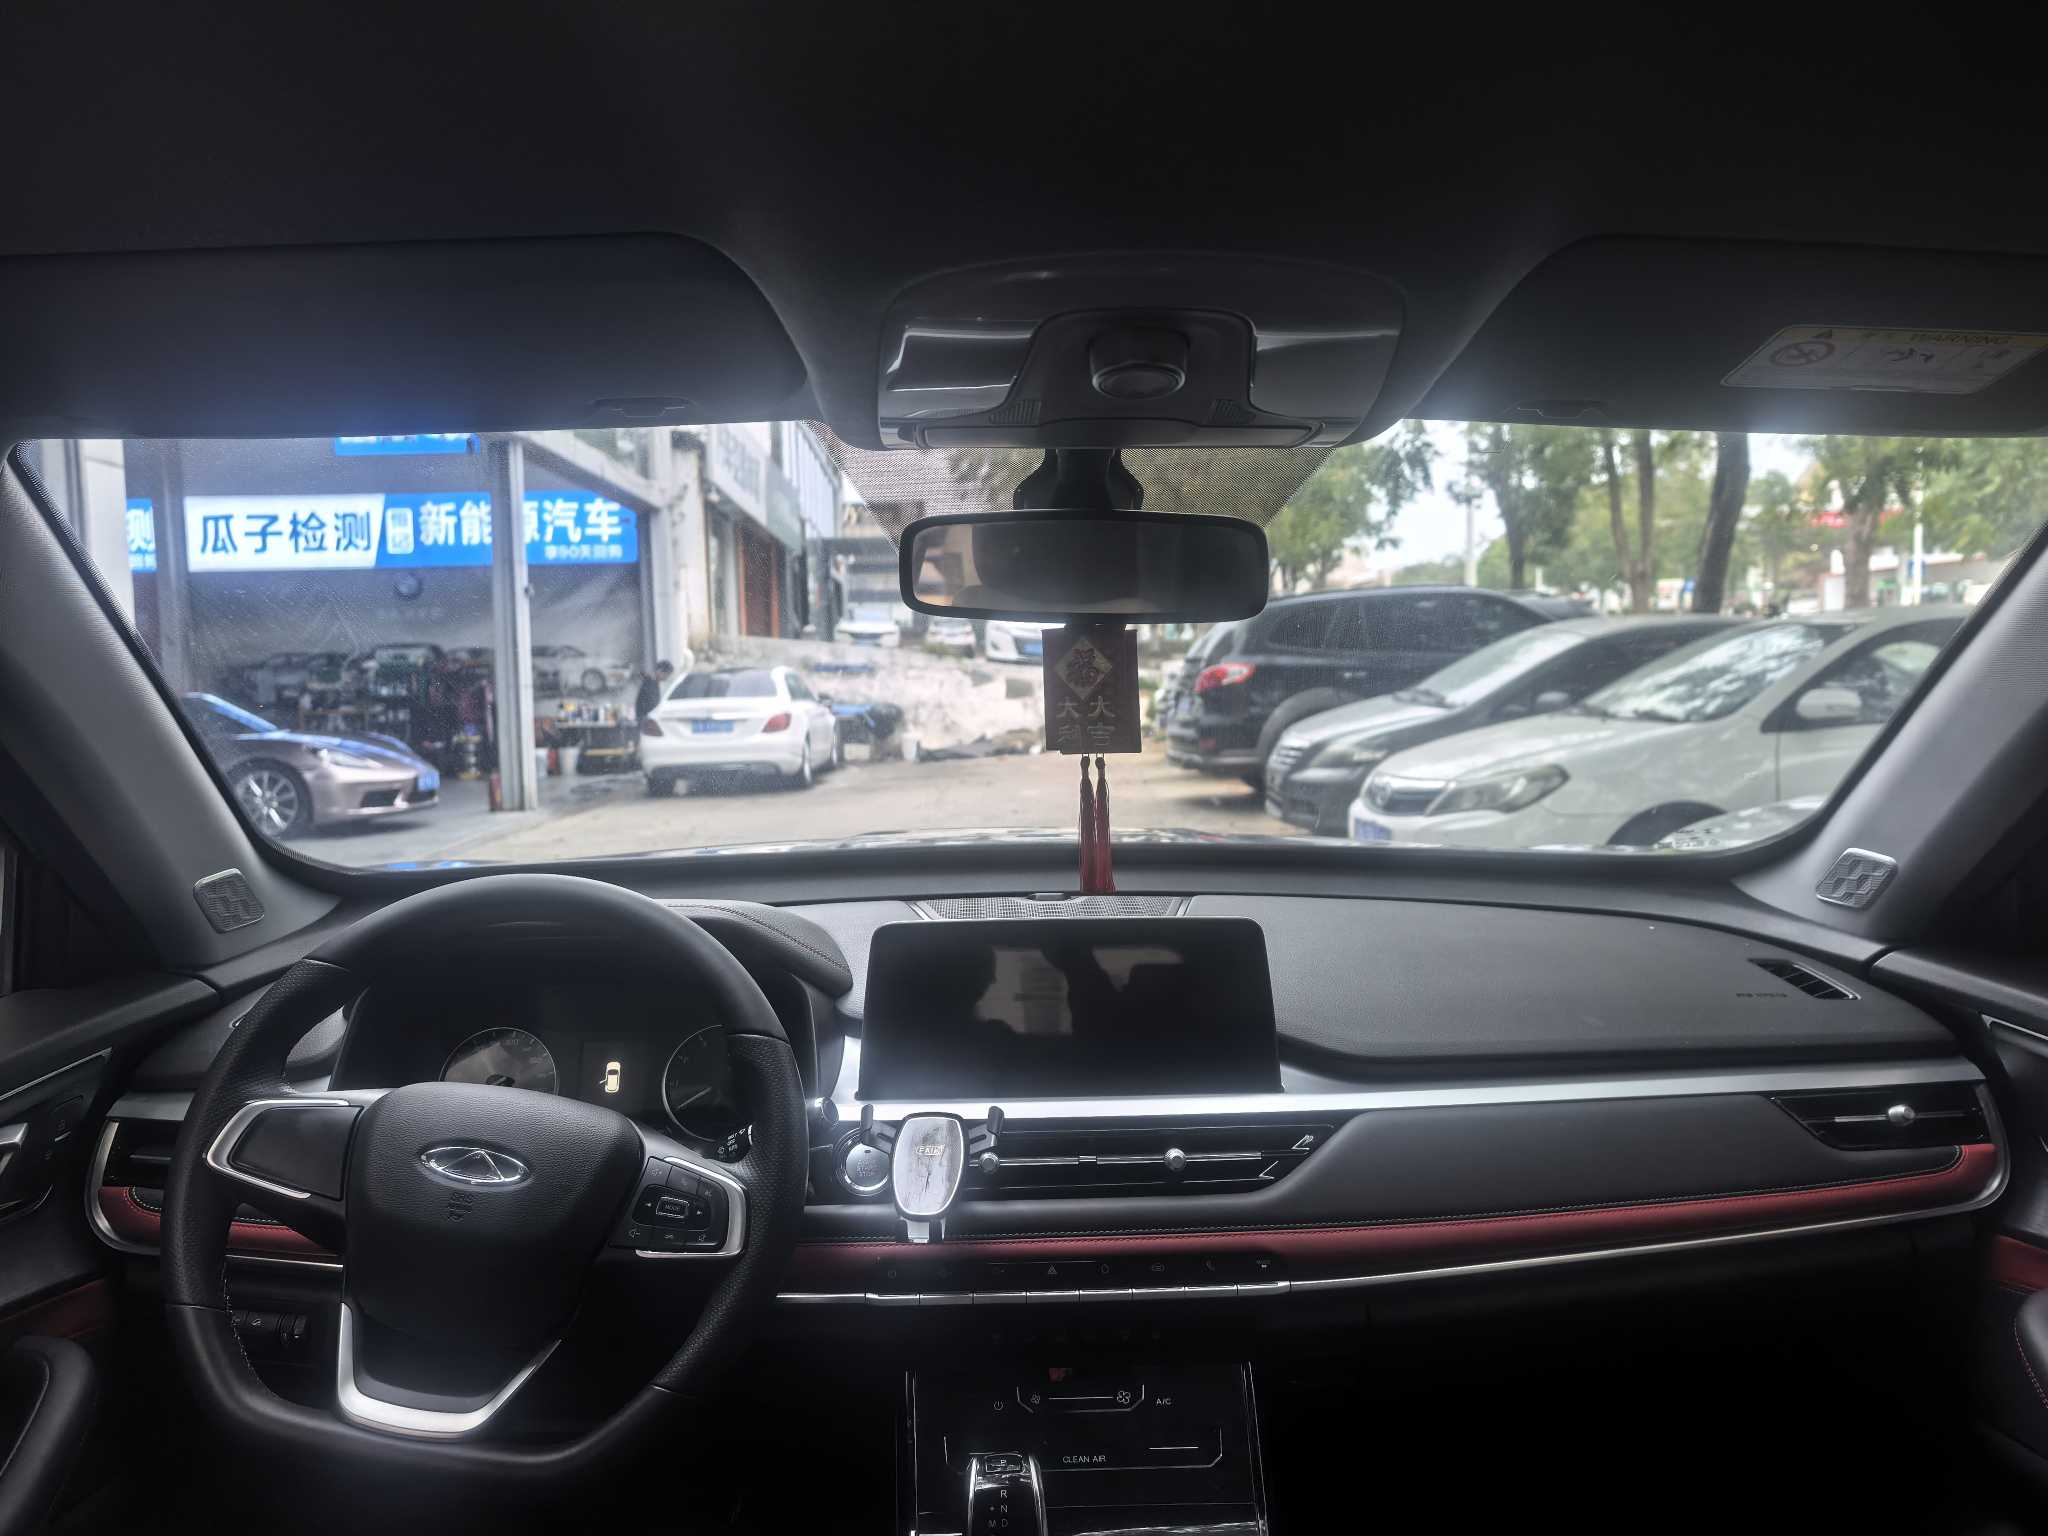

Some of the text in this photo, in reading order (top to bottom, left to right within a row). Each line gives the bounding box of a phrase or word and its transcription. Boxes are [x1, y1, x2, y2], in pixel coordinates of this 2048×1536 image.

[200, 511, 372, 555] 瓜子检测
[1062, 1454, 1107, 1464] CLEAN AIR
[1000, 1489, 1008, 1499] R
[1000, 1504, 1008, 1513] N
[1001, 1518, 1009, 1528] D
